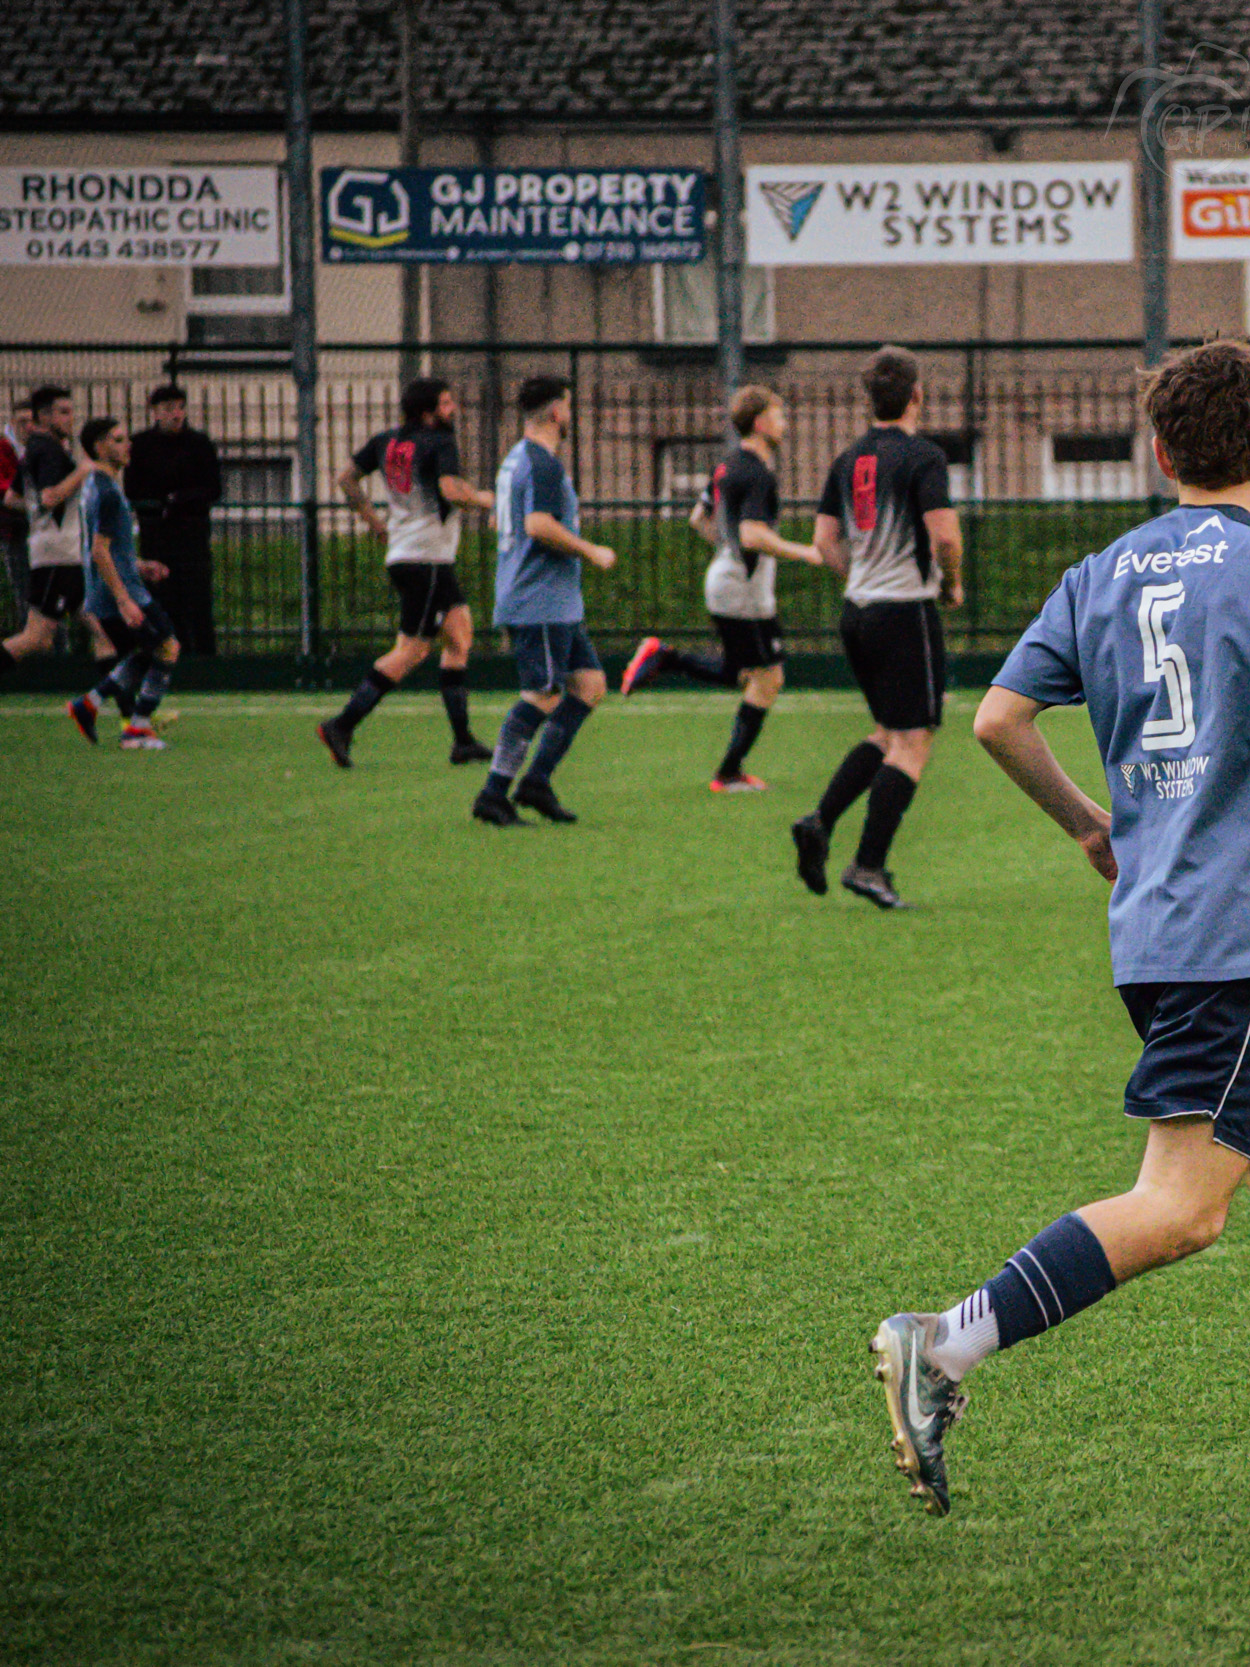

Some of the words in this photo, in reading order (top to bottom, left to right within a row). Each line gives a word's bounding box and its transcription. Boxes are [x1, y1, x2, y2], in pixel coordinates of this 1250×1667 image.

[22, 174, 220, 202] RHONDDA
[430, 174, 486, 205] GJ
[494, 173, 698, 205] PROPERTY
[836, 180, 901, 212] W2
[915, 178, 1121, 211] WINDOW
[177, 207, 270, 232] CLINIC
[430, 205, 697, 237] MAINTENANCE
[882, 214, 1073, 247] SYSTEMS
[26, 238, 109, 259] 01443
[1137, 579, 1196, 751] 5
[1140, 762, 1162, 782] W2
